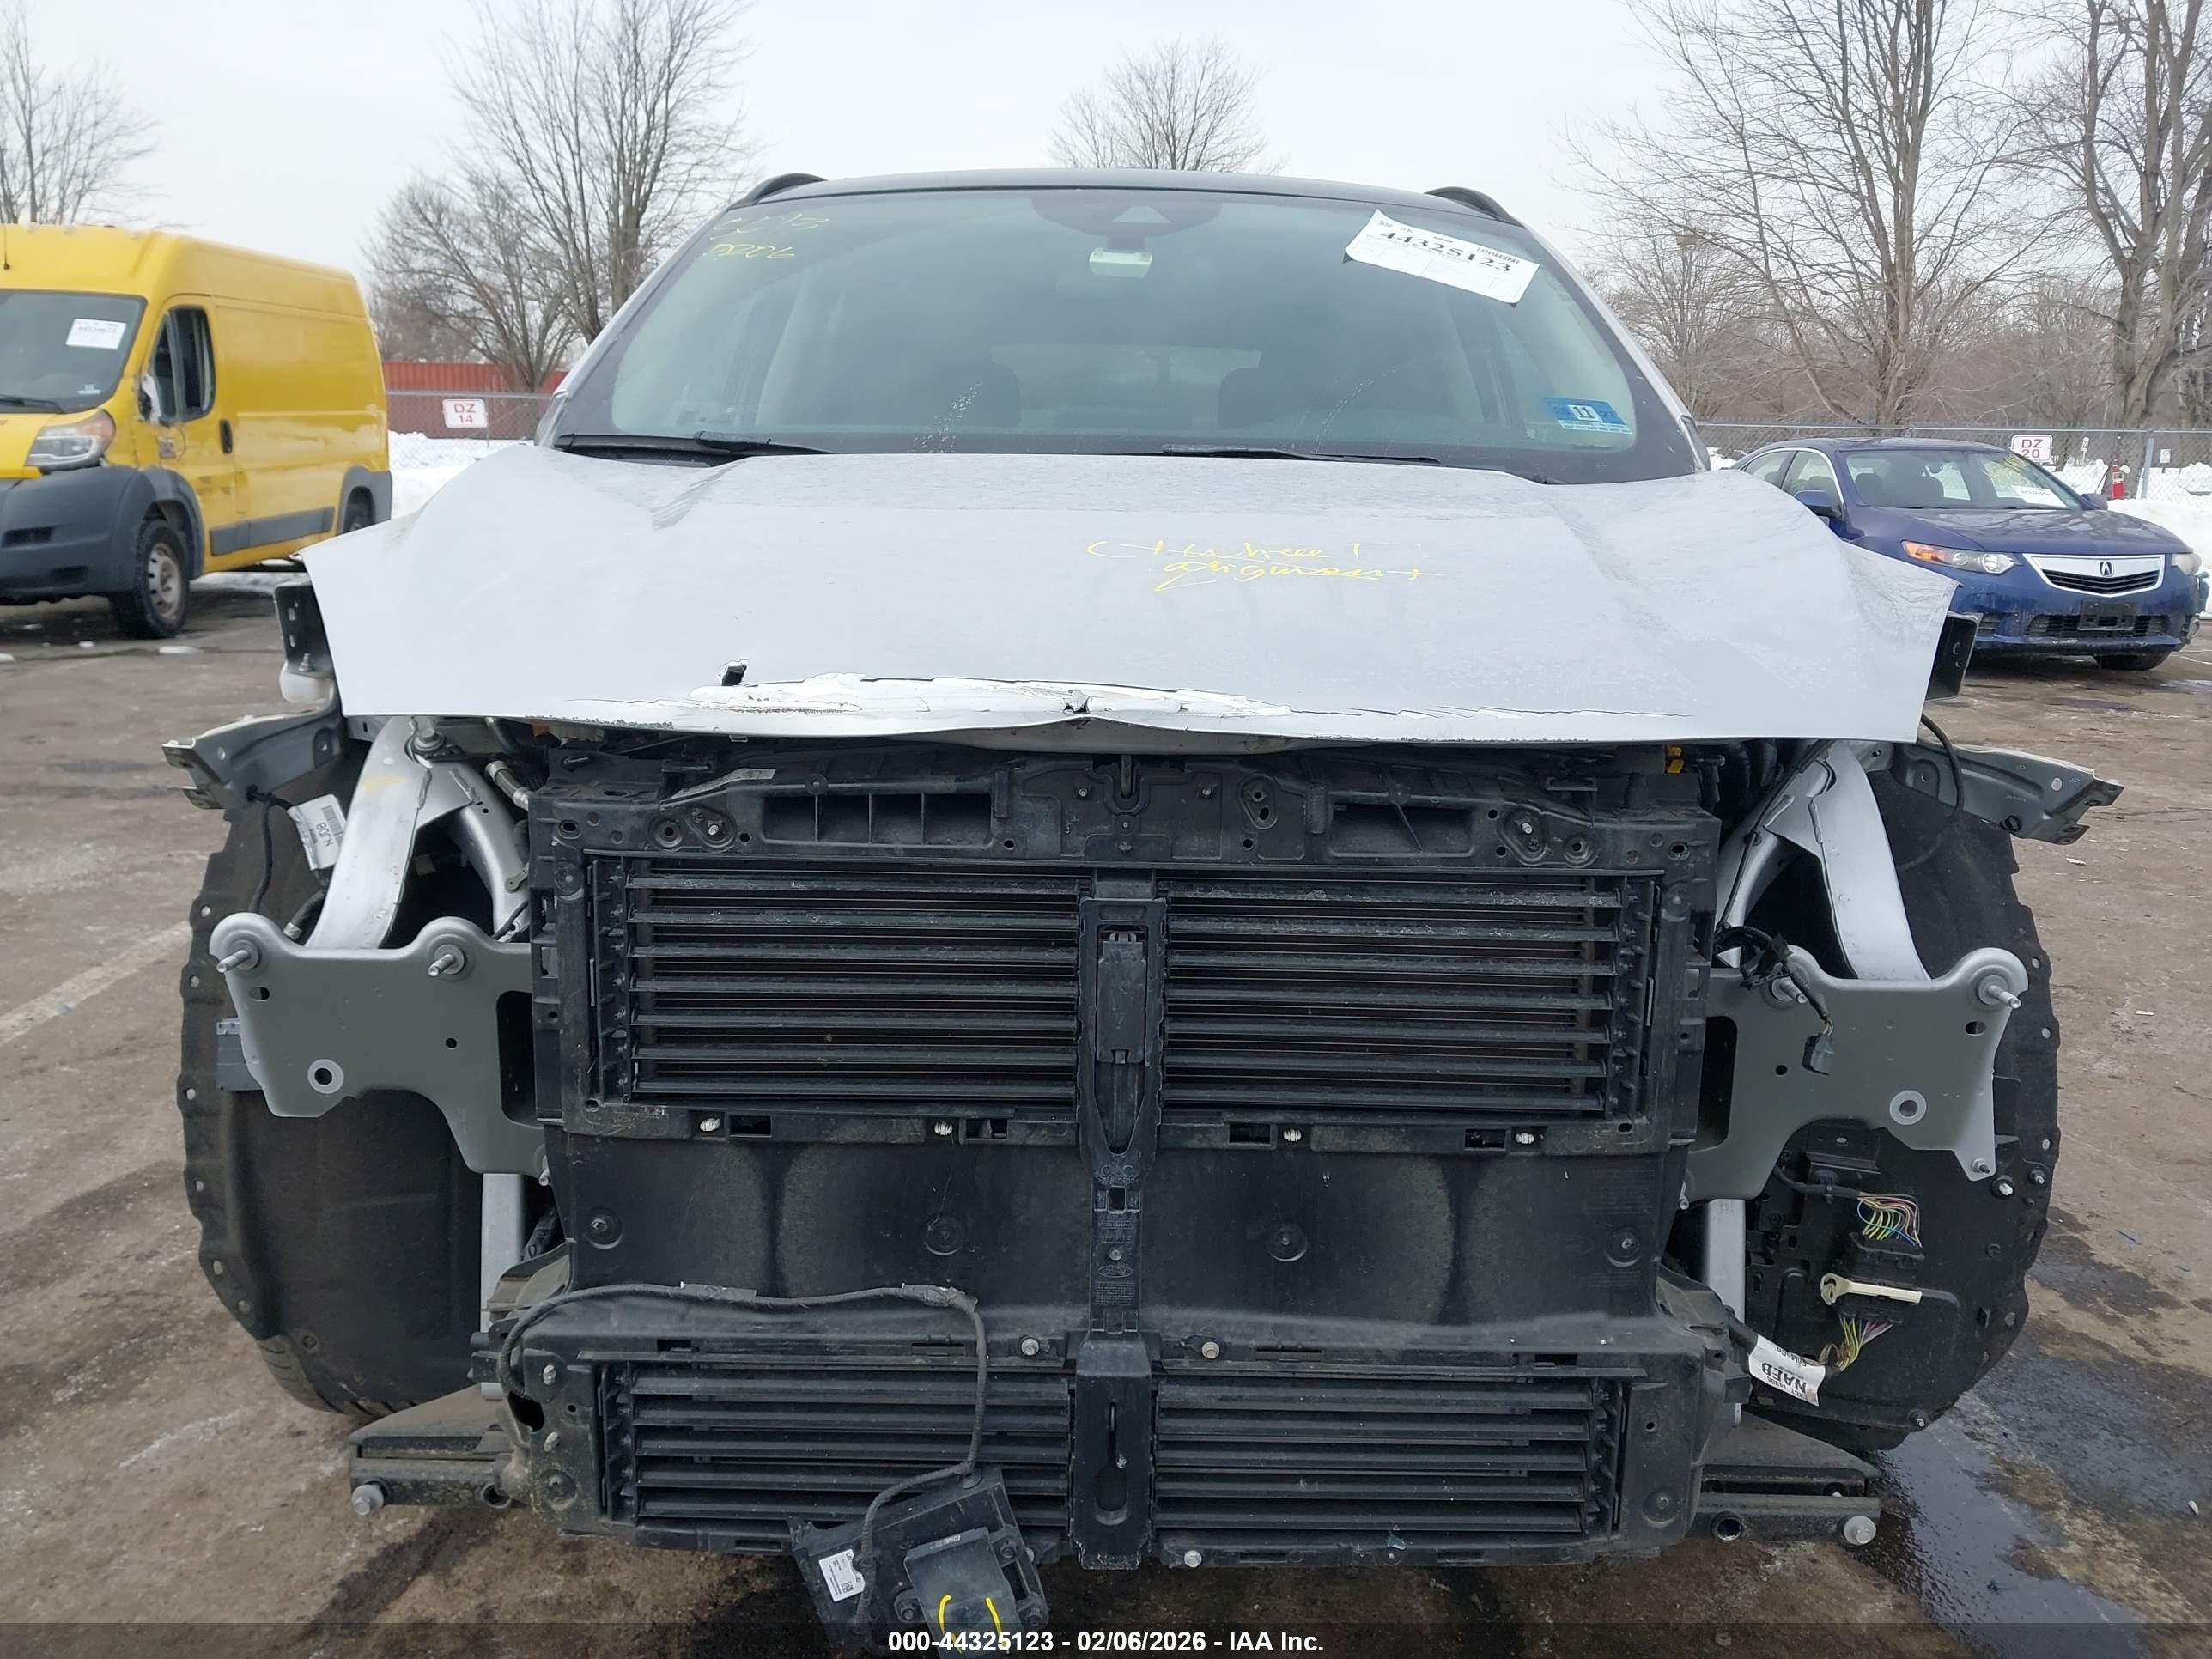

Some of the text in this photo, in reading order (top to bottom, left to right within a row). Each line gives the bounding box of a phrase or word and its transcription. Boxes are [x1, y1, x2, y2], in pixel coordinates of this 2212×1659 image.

[1380, 232, 1511, 272] 44325123
[453, 403, 476, 413] DZ
[458, 414, 473, 423] 14
[2021, 439, 2044, 448] DZ
[2021, 448, 2040, 459] 20
[1761, 1362, 1807, 1394] NAEB
